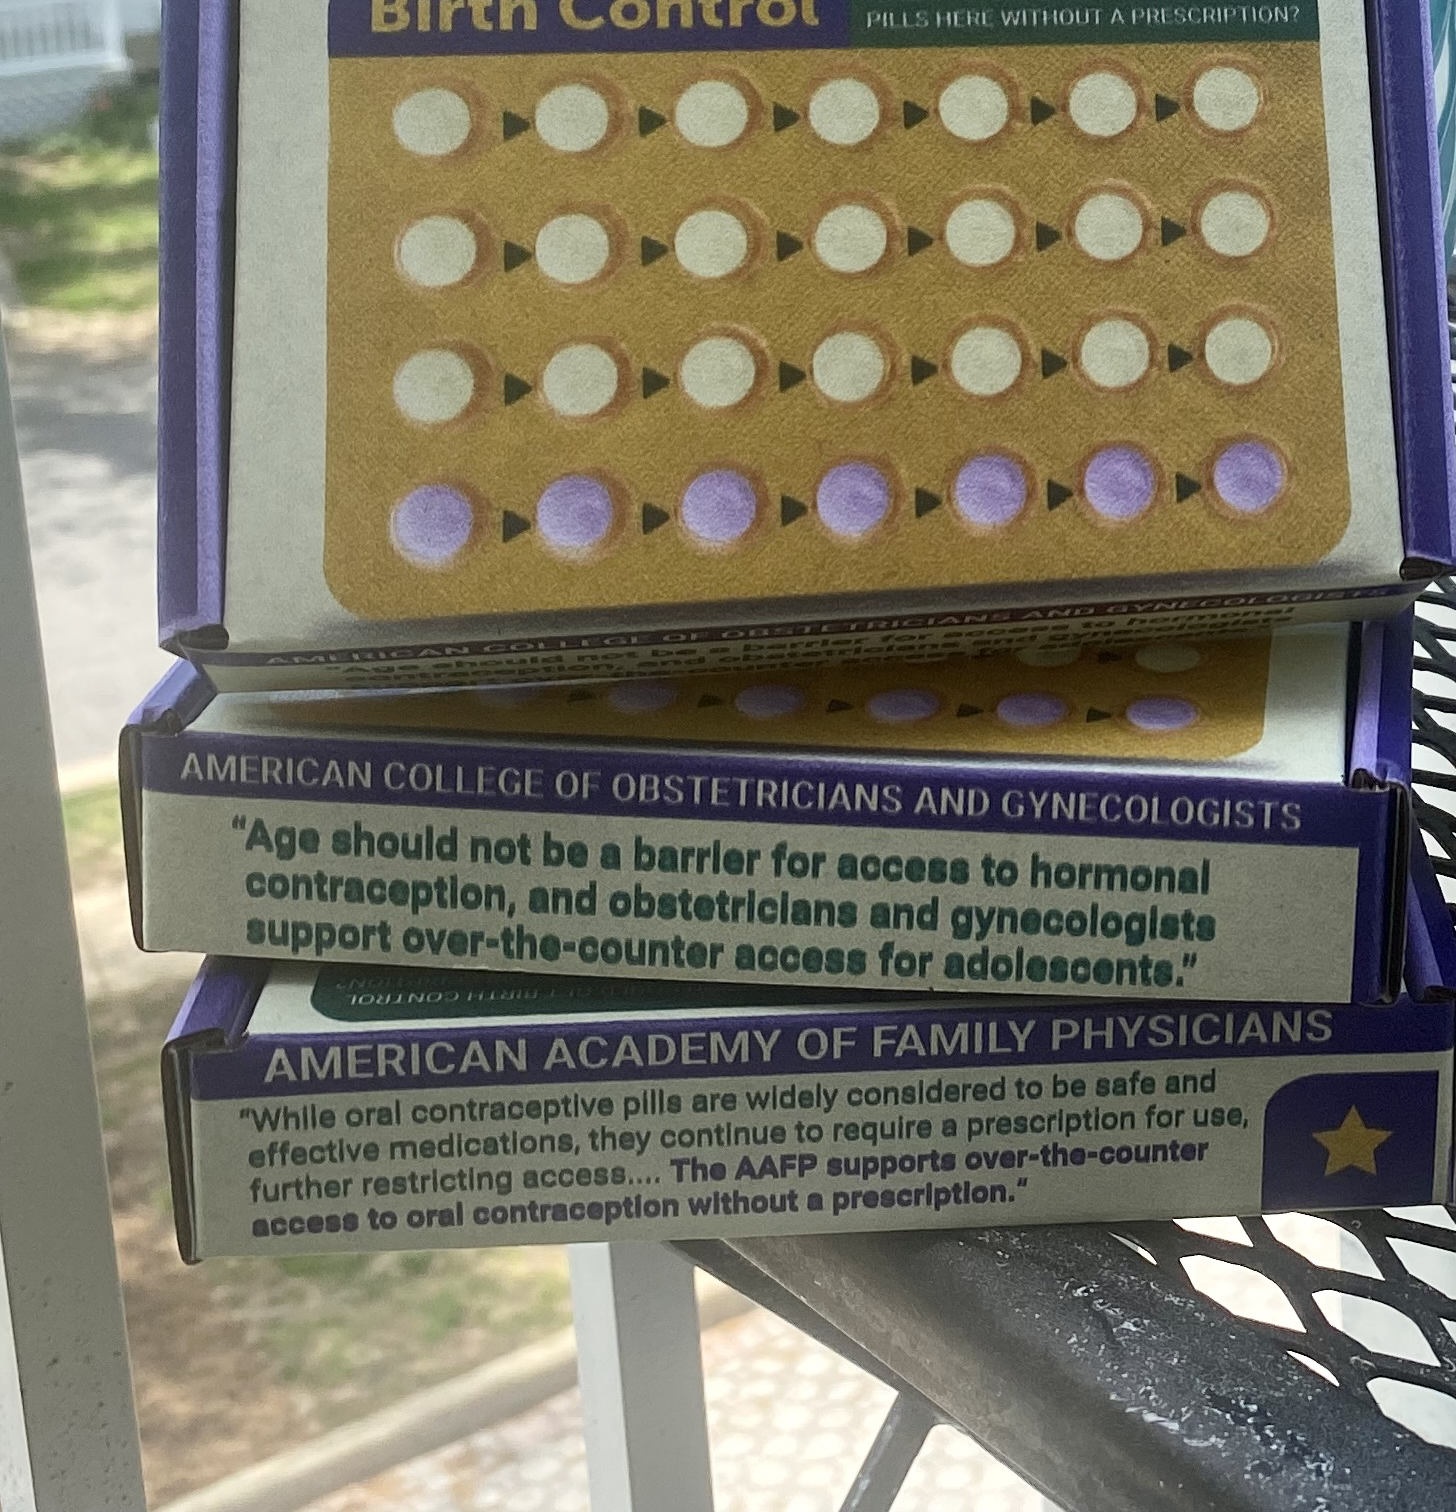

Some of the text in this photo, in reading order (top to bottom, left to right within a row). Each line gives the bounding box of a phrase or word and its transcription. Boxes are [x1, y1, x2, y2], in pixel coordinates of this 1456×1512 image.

[865, 5, 1300, 29] PILLS HERE WITHOUT A PRESCRIPTION?
[179, 751, 1301, 830] AMERICAN COLLEGE OF OBSTETRICIANS AND GYNECOLOGISTS
[231, 815, 1210, 895] “Age should not be a barrier for access to hormonal
[245, 872, 1216, 947] contraception, and obstetricians and gynecologists
[245, 920, 1197, 986] support over-the-counter access for adolescents.”
[265, 1008, 1332, 1081] AMERICAN ACADEMY OF FAMILY PHYSICIANS
[238, 1069, 1216, 1131] “While oral contraceptive pills are widely considered to be safe and
[249, 1139, 1209, 1203] further restricting access.... The AAFP supports over-the-counter
